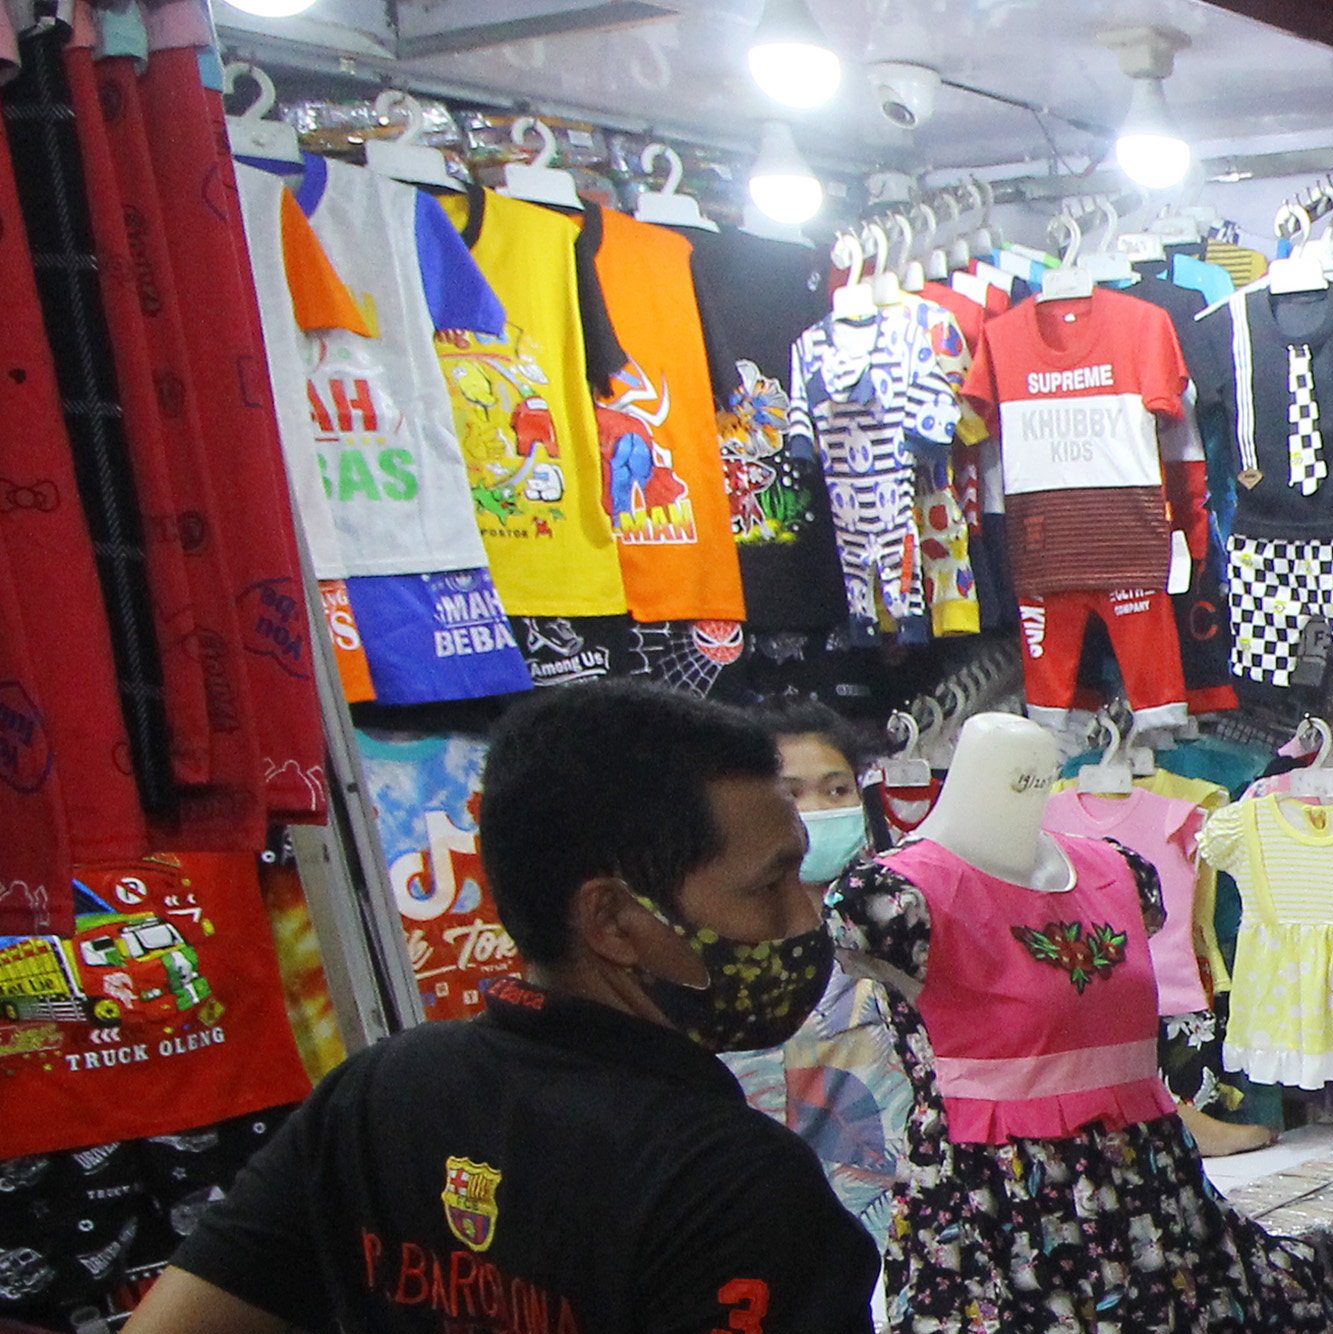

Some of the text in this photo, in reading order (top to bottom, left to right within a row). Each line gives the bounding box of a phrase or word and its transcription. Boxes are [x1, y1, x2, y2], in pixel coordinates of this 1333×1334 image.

[1027, 364, 1114, 394] SUPREME
[1021, 407, 1123, 442] KHUBBY
[1051, 439, 1094, 463] KIDS
[619, 500, 698, 545] MAN
[529, 650, 606, 679] Among Us
[65, 1026, 226, 1072] TRUCK OLENG
